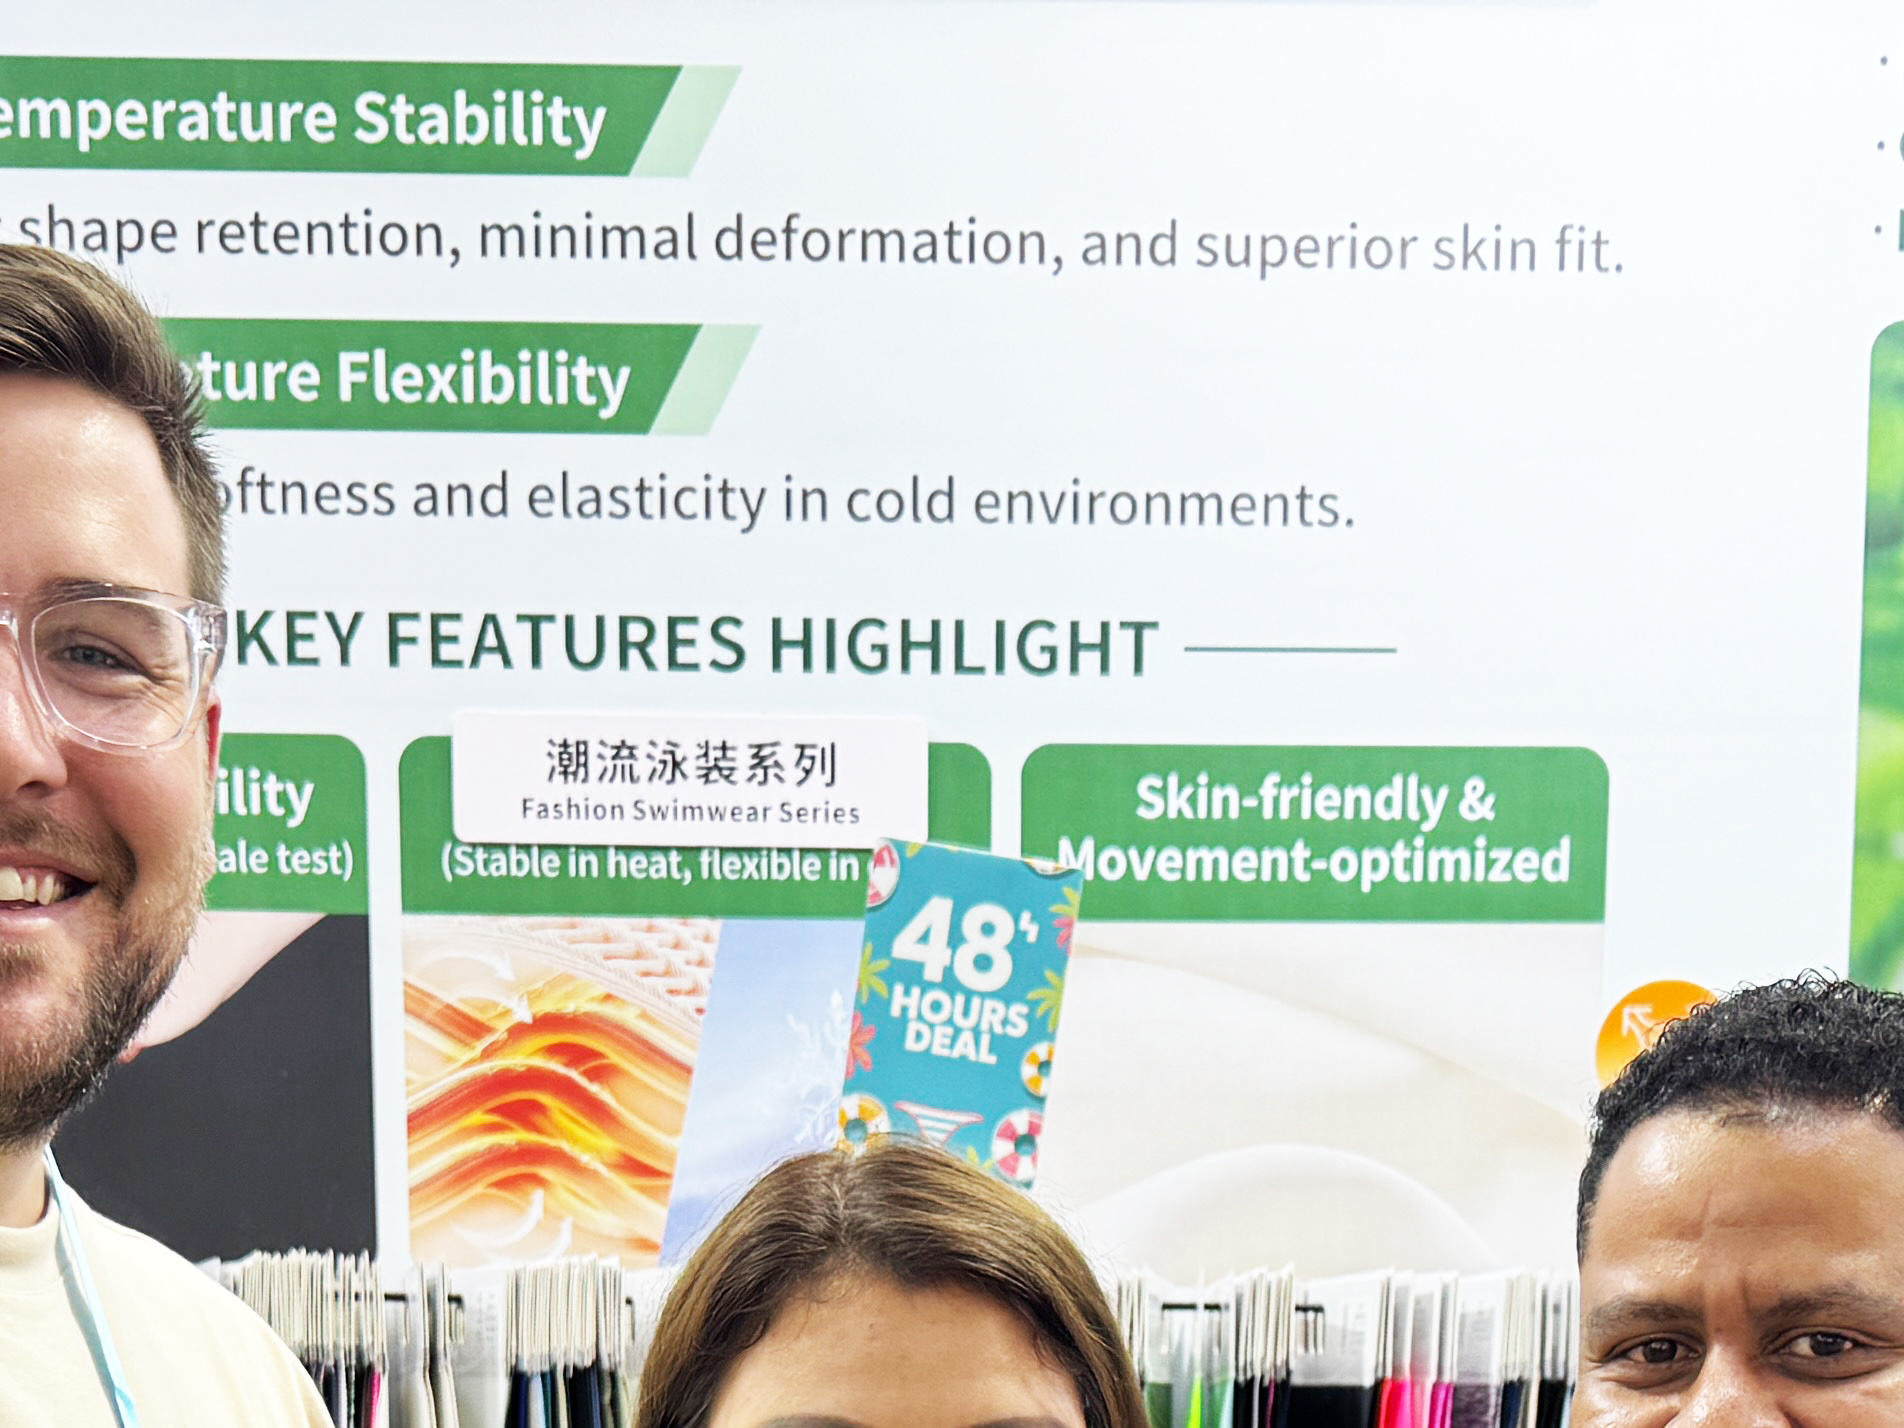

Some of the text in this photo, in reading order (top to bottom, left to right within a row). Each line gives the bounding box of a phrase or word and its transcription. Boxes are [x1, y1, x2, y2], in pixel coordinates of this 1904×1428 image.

[355, 90, 606, 160] Stability
[19, 204, 1623, 280] shape retention, minimal deformation, and superior skin fit.
[339, 349, 630, 419] Flexibility
[413, 471, 1355, 533] and elasticity in cold environments.
[236, 610, 1158, 677] KEY FEATURES HIGHLIGHT
[546, 738, 837, 788] 潮流泳装系列
[522, 798, 860, 825] Fashion Swimwear Series
[1136, 773, 1496, 831] Skin-friendly &
[277, 842, 354, 882] test)
[441, 844, 859, 885] (Stable in heat, flexible in
[1058, 835, 1571, 893] Movement-optimized
[890, 983, 1028, 1036] HOURS
[904, 1022, 998, 1066] DEAL
